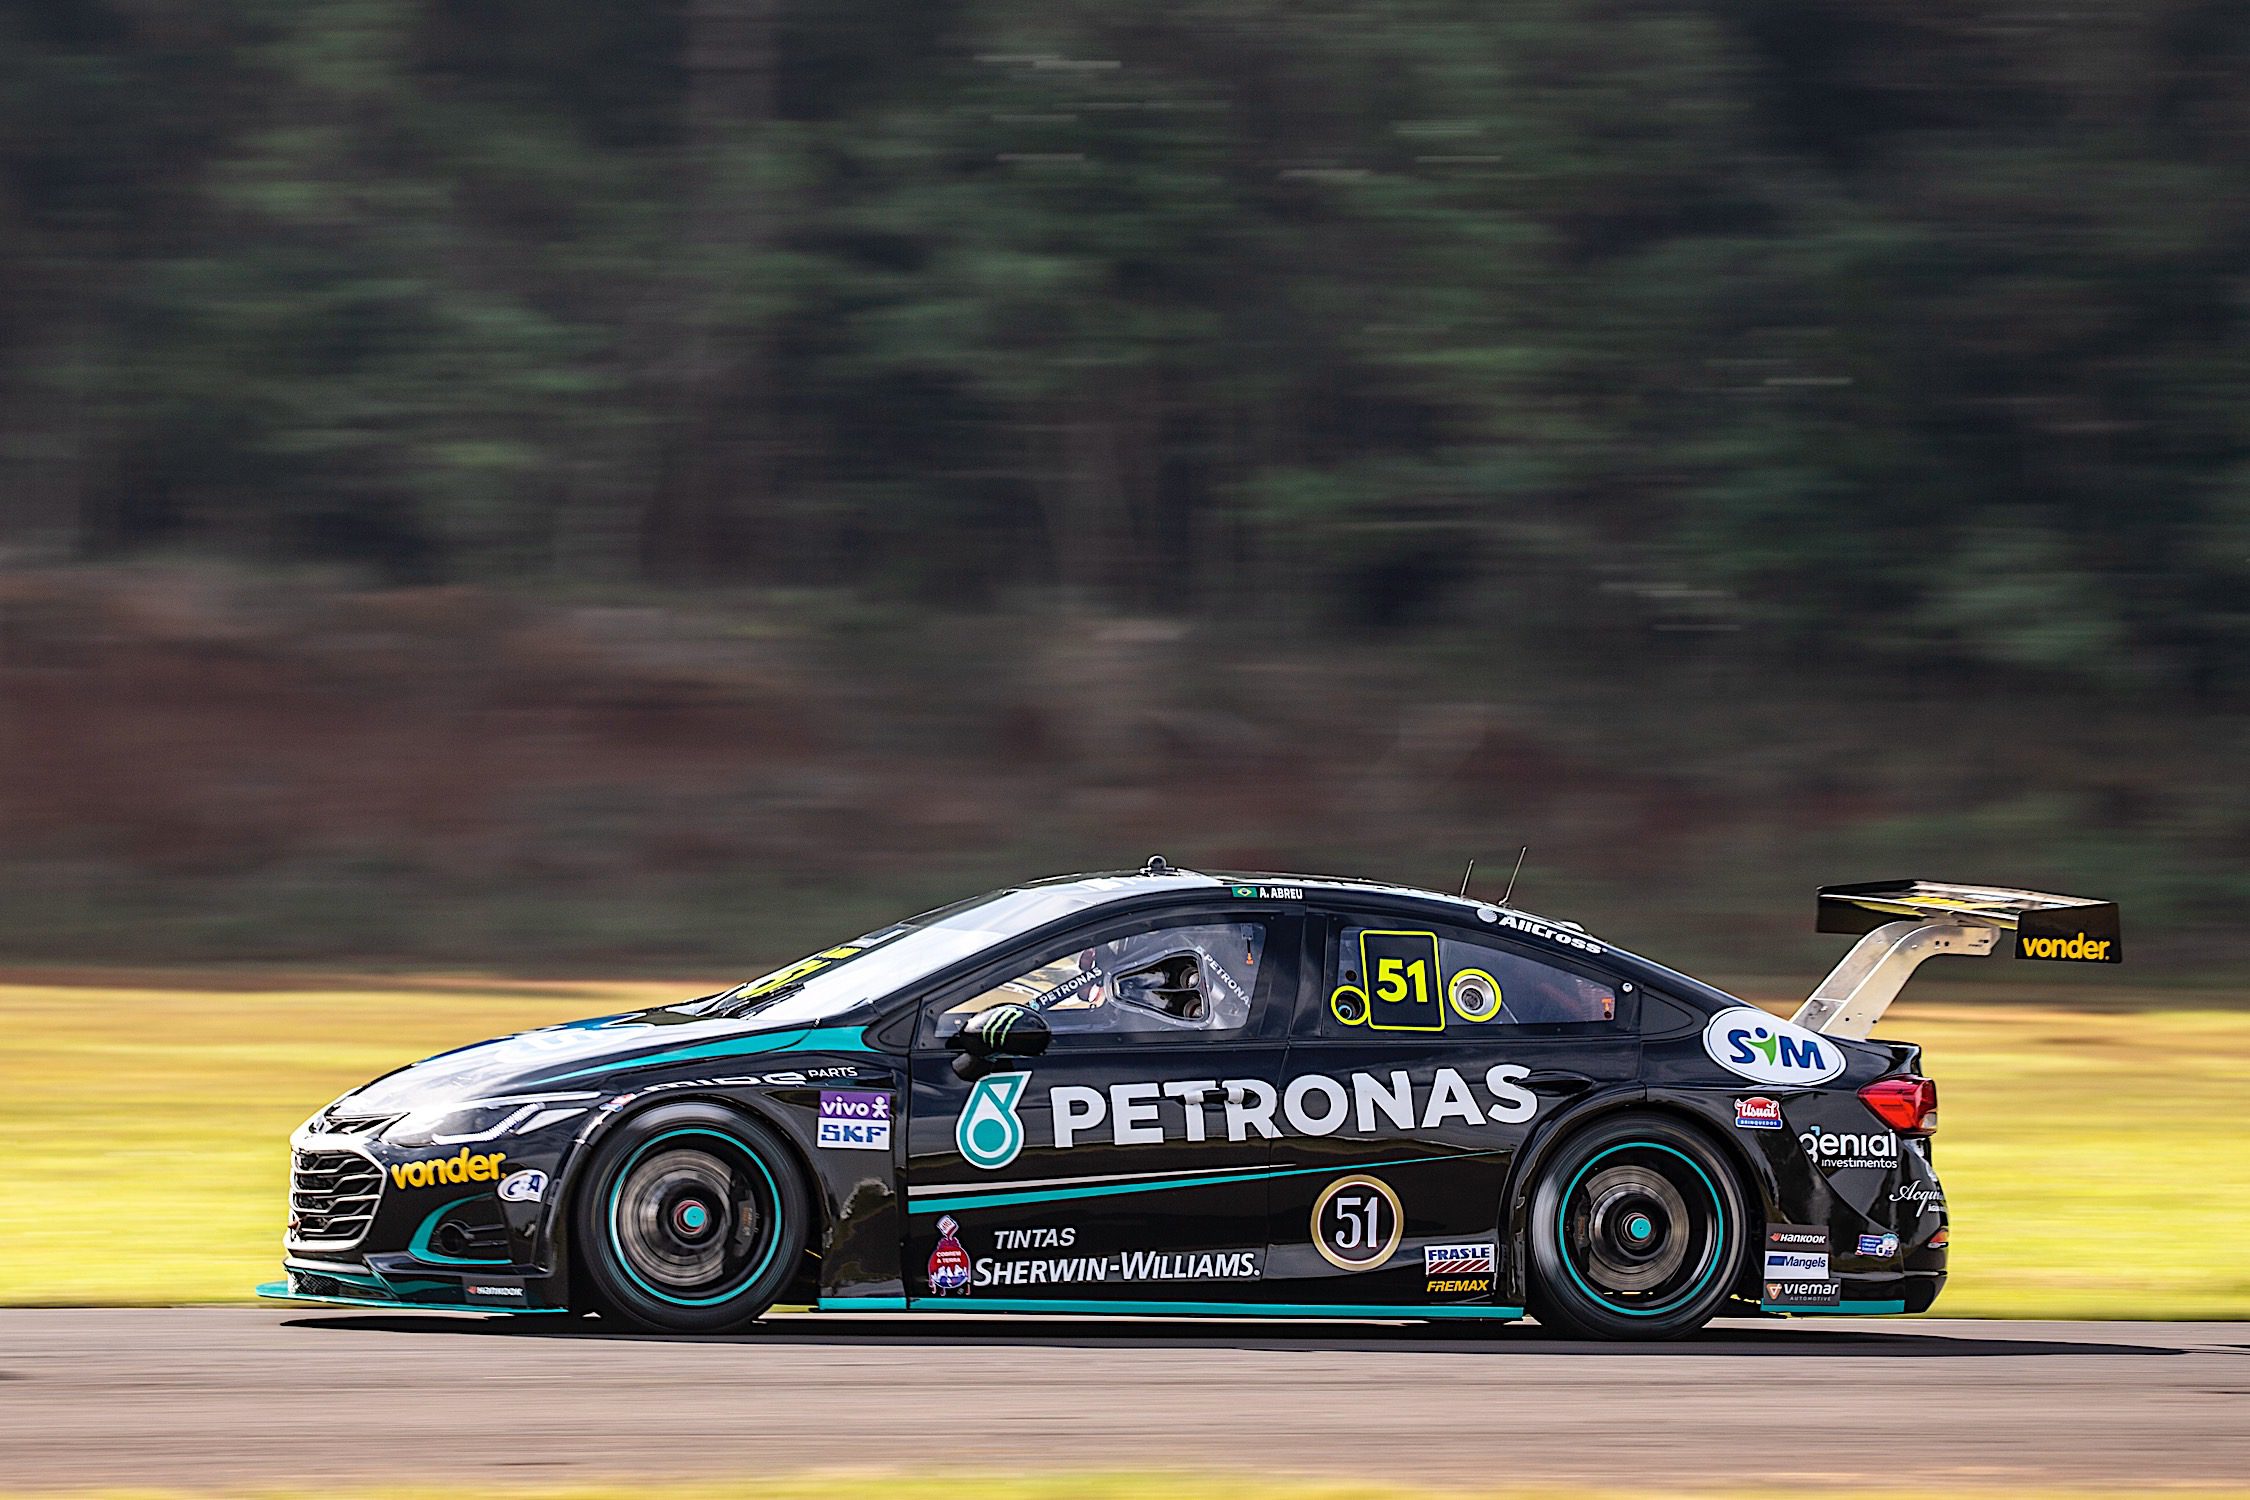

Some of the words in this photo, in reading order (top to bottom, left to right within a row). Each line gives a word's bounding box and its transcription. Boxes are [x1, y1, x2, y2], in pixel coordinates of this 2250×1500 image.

[1260, 887, 1270, 898] A.
[1271, 887, 1303, 900] ABREU
[1039, 967, 1103, 1006] PETRONAS
[1203, 953, 1251, 1008] PETRONA
[1376, 958, 1428, 1003] 51
[807, 1066, 858, 1078] PARTS
[821, 1096, 870, 1117] vivo
[1050, 1064, 1537, 1147] PETRONAS
[821, 1124, 887, 1143] SKF
[1822, 1157, 1897, 1169] investimentos
[1335, 1197, 1377, 1249] 51
[993, 1228, 1075, 1250] TINTAS
[1784, 1256, 1826, 1270] Mangels
[1427, 1280, 1490, 1292] FREMAX
